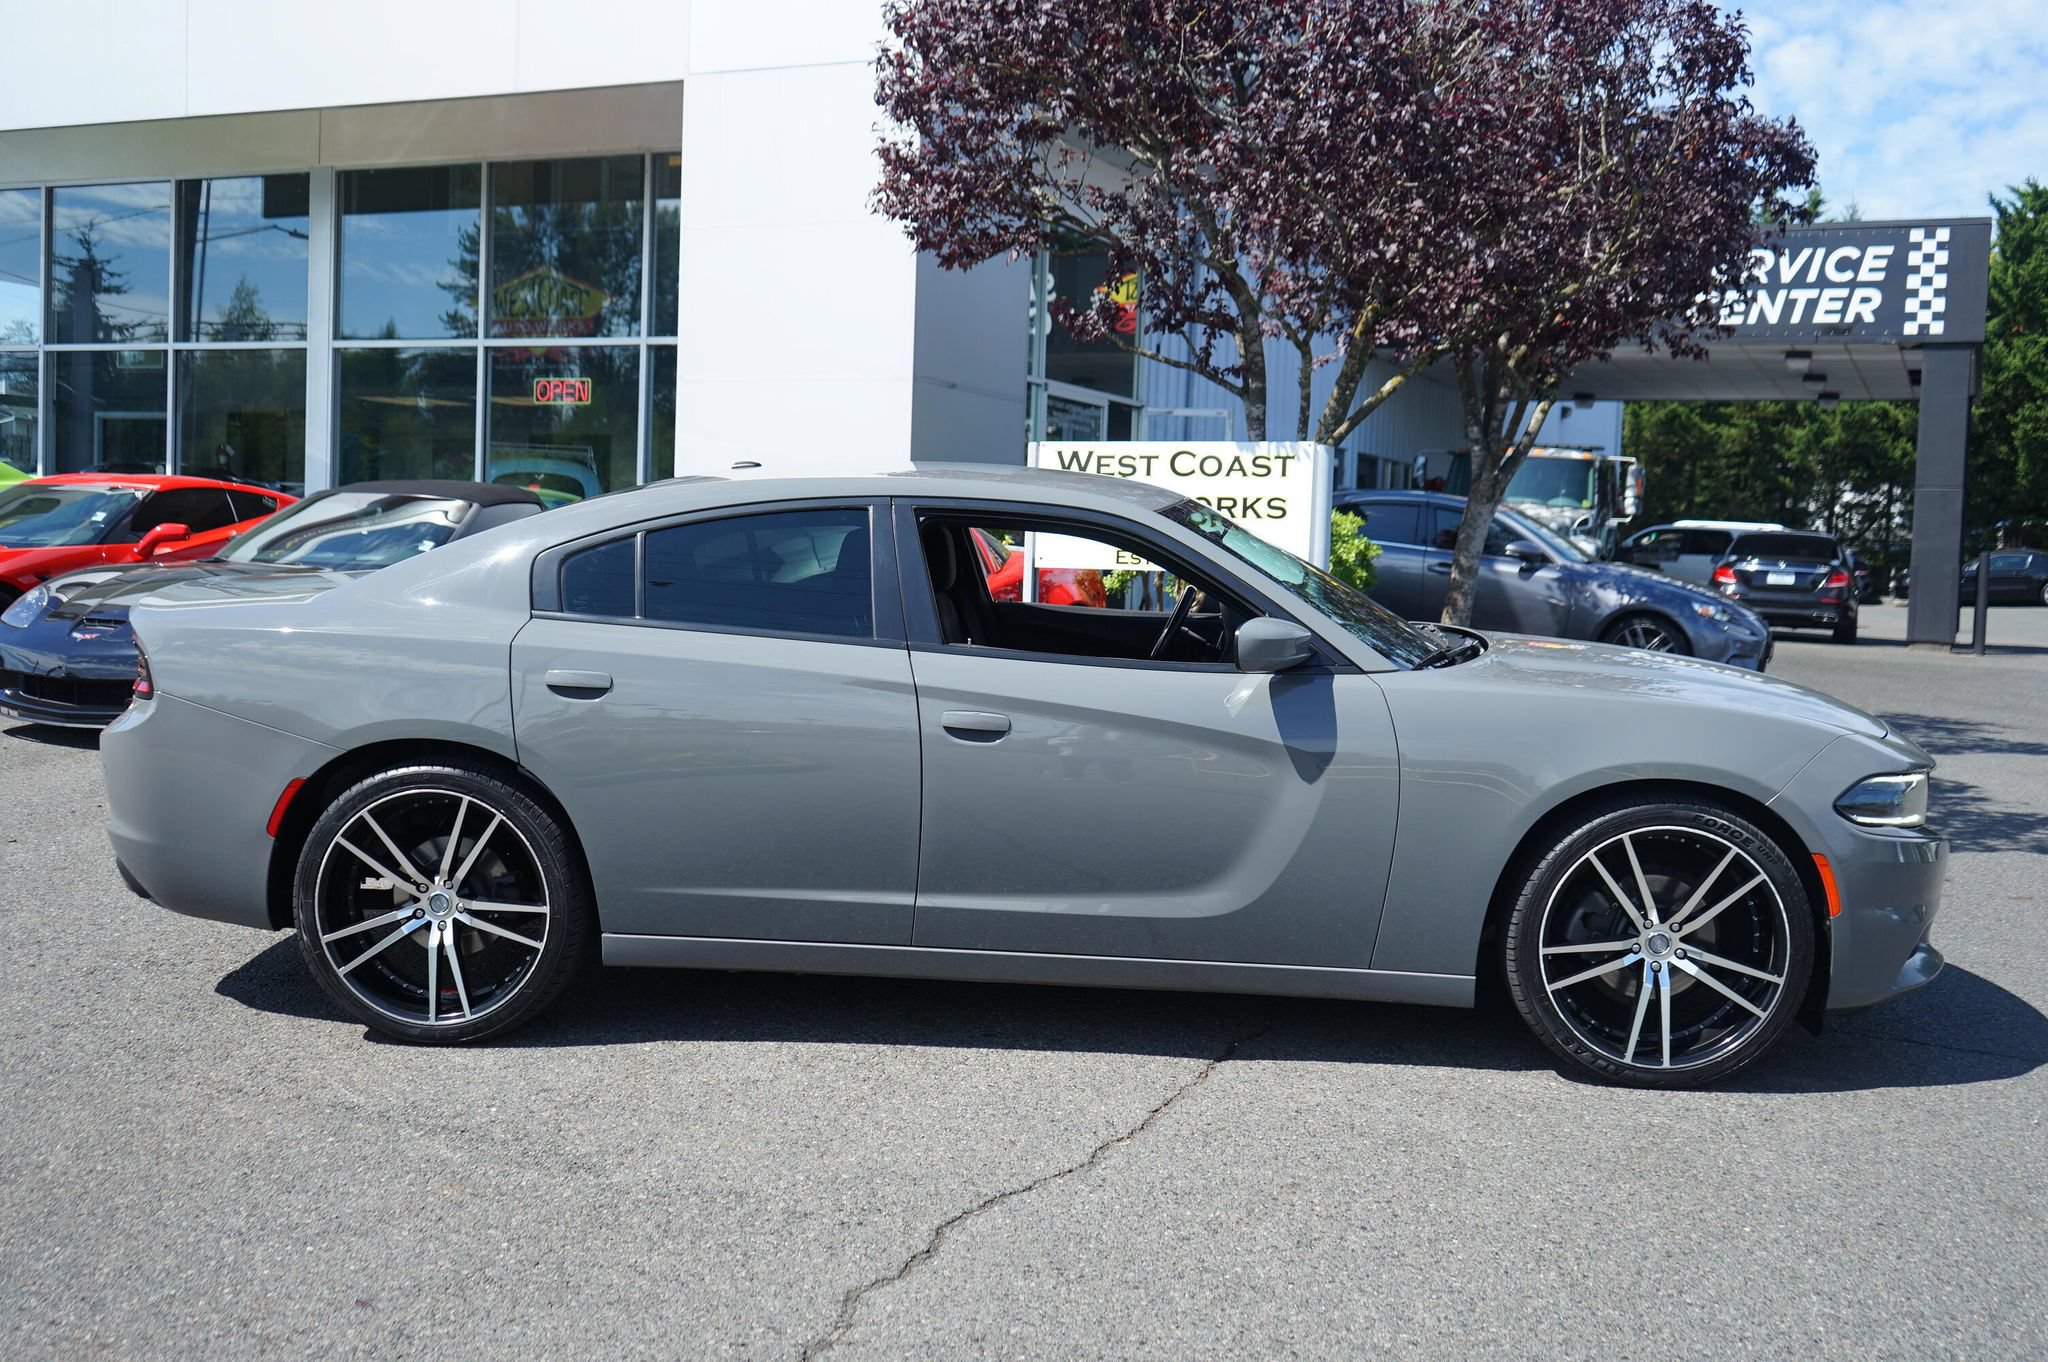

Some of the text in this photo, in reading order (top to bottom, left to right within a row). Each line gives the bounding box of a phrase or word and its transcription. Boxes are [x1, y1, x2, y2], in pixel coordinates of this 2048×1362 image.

[1711, 245, 1895, 284] RVICE
[536, 380, 589, 402] OPEN
[1057, 450, 1296, 478] WEST COAST
[1116, 550, 1149, 565] ES
[1693, 813, 1758, 848] FORCE
